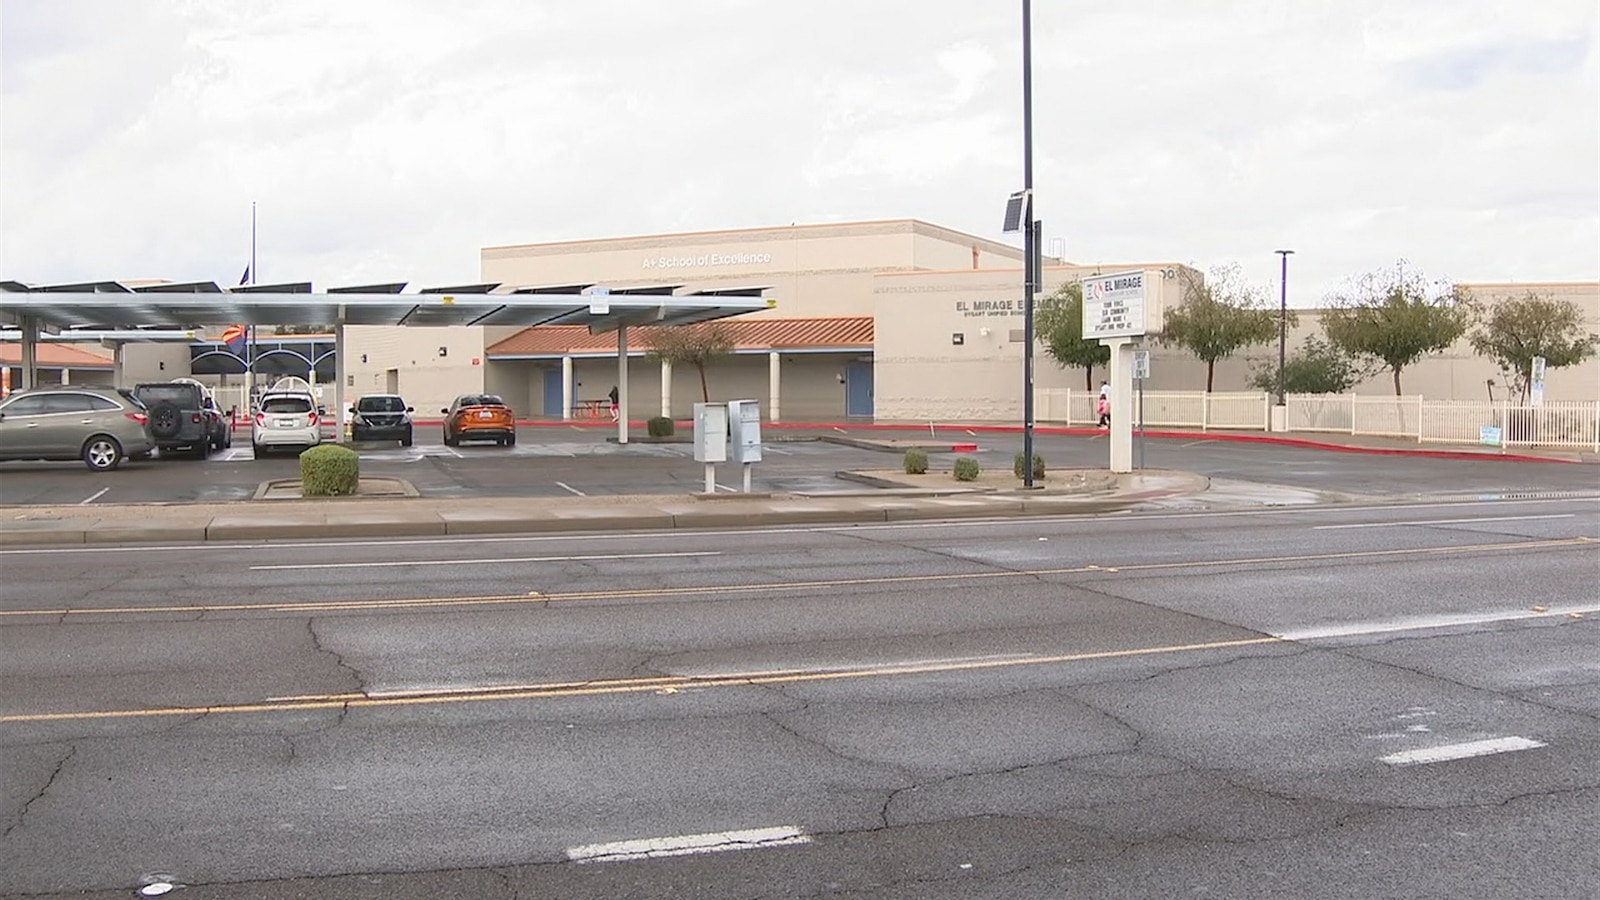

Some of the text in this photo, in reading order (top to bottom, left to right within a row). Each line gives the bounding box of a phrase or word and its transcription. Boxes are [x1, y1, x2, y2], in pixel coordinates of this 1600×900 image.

[642, 252, 771, 269] A+ School of Excellence
[1105, 281, 1113, 292] EL
[1114, 277, 1142, 290] MIRAGE
[956, 301, 969, 311] EL
[973, 300, 1013, 311] MIRAGE
